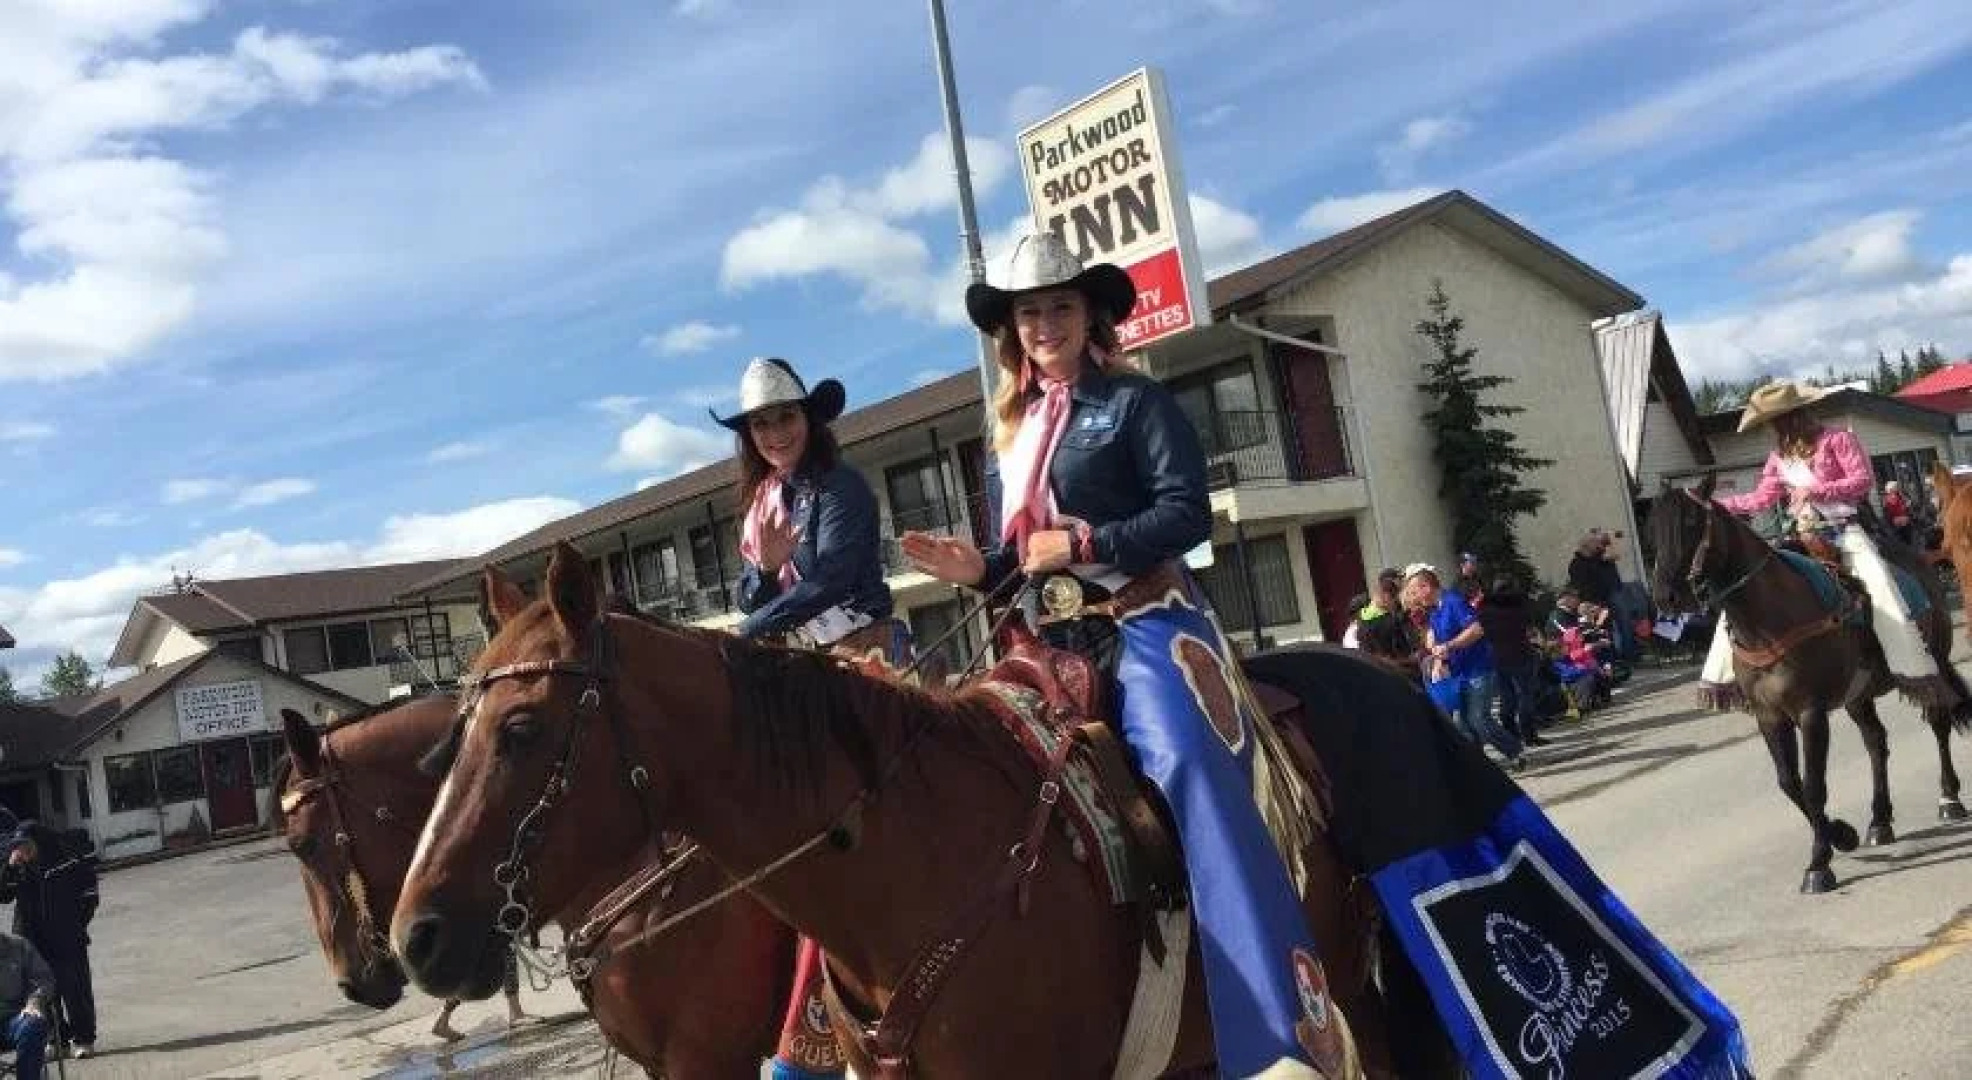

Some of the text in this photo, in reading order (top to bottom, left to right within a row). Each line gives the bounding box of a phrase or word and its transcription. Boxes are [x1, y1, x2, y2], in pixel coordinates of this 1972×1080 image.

[1030, 89, 1147, 174] Parkwood
[1042, 138, 1151, 205] MOTOR
[1049, 173, 1161, 263] INN
[1138, 286, 1161, 311] TV
[1115, 303, 1184, 343] NETTES
[195, 715, 251, 734] OFFICE
[231, 699, 258, 715] INN
[1589, 998, 1632, 1040] 2015
